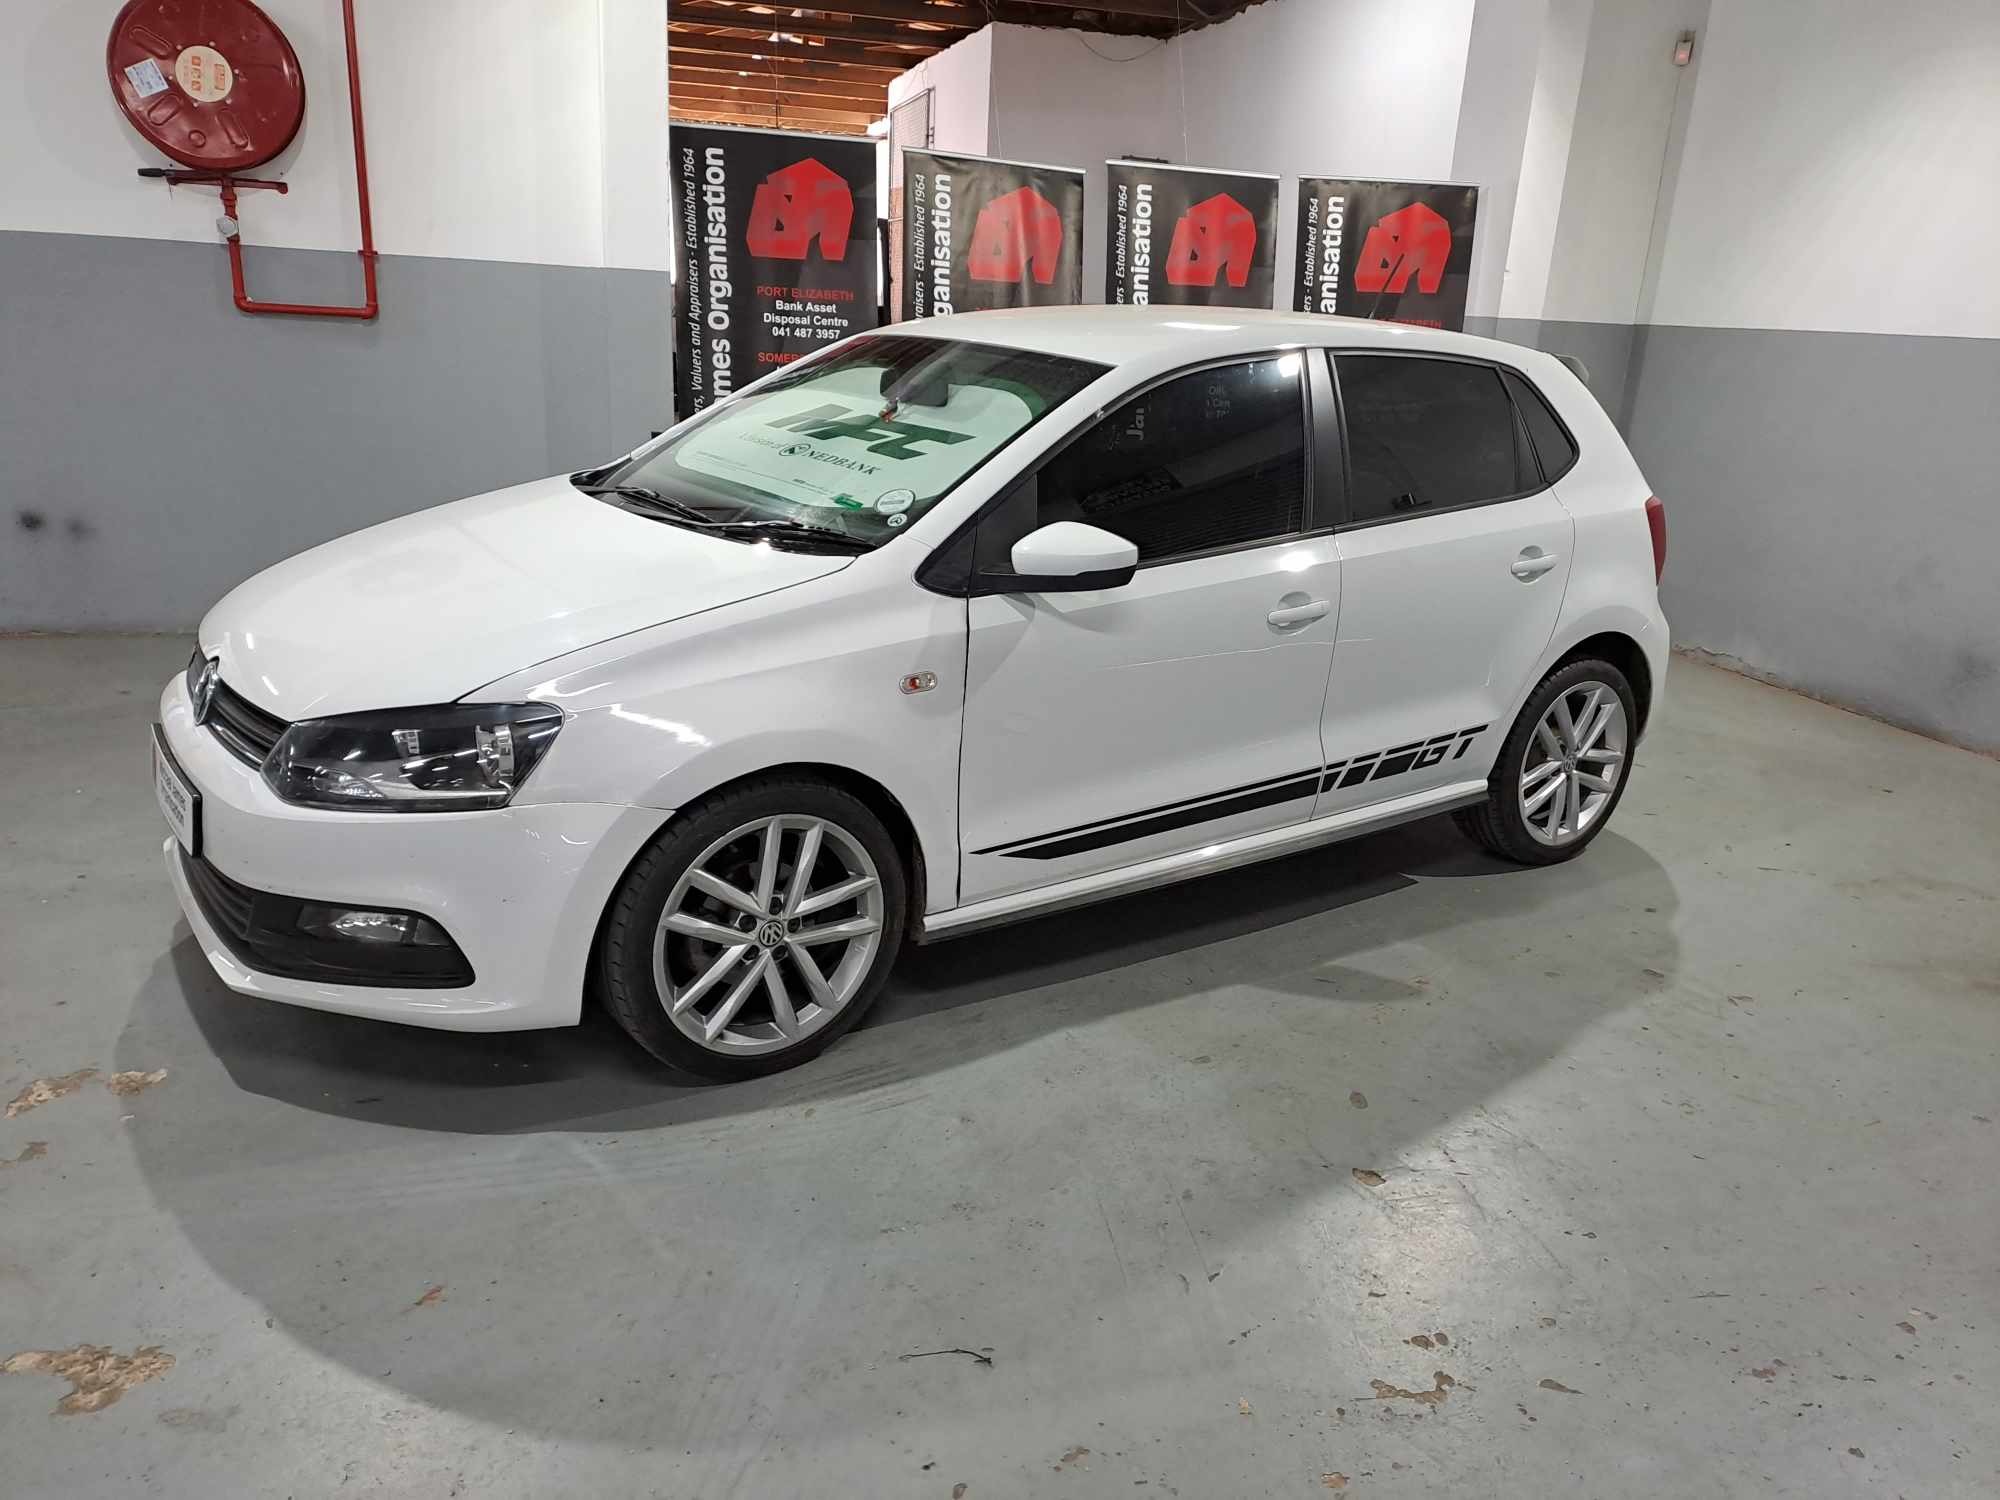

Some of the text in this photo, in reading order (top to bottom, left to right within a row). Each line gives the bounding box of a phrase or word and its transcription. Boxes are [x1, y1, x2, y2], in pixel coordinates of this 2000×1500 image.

[683, 148, 695, 177] 1964
[915, 174, 926, 205] 1964
[1118, 185, 1128, 213] 1964
[685, 181, 698, 249] Established
[1309, 198, 1319, 225] 1964
[702, 147, 732, 329] Organisation
[913, 207, 925, 271] Established
[1115, 213, 1127, 277] Established
[1304, 226, 1316, 286] Established
[687, 259, 702, 321] Appraisers
[757, 286, 854, 301] PORT ELIZABETH
[763, 313, 848, 327] Disposal Centre
[776, 300, 837, 313] Bank Asset
[689, 322, 701, 346] and
[772, 326, 841, 339] 041 487 3957
[691, 347, 703, 390] Valuers
[806, 449, 882, 475] NEDBANK
[1412, 724, 1489, 770] GT
